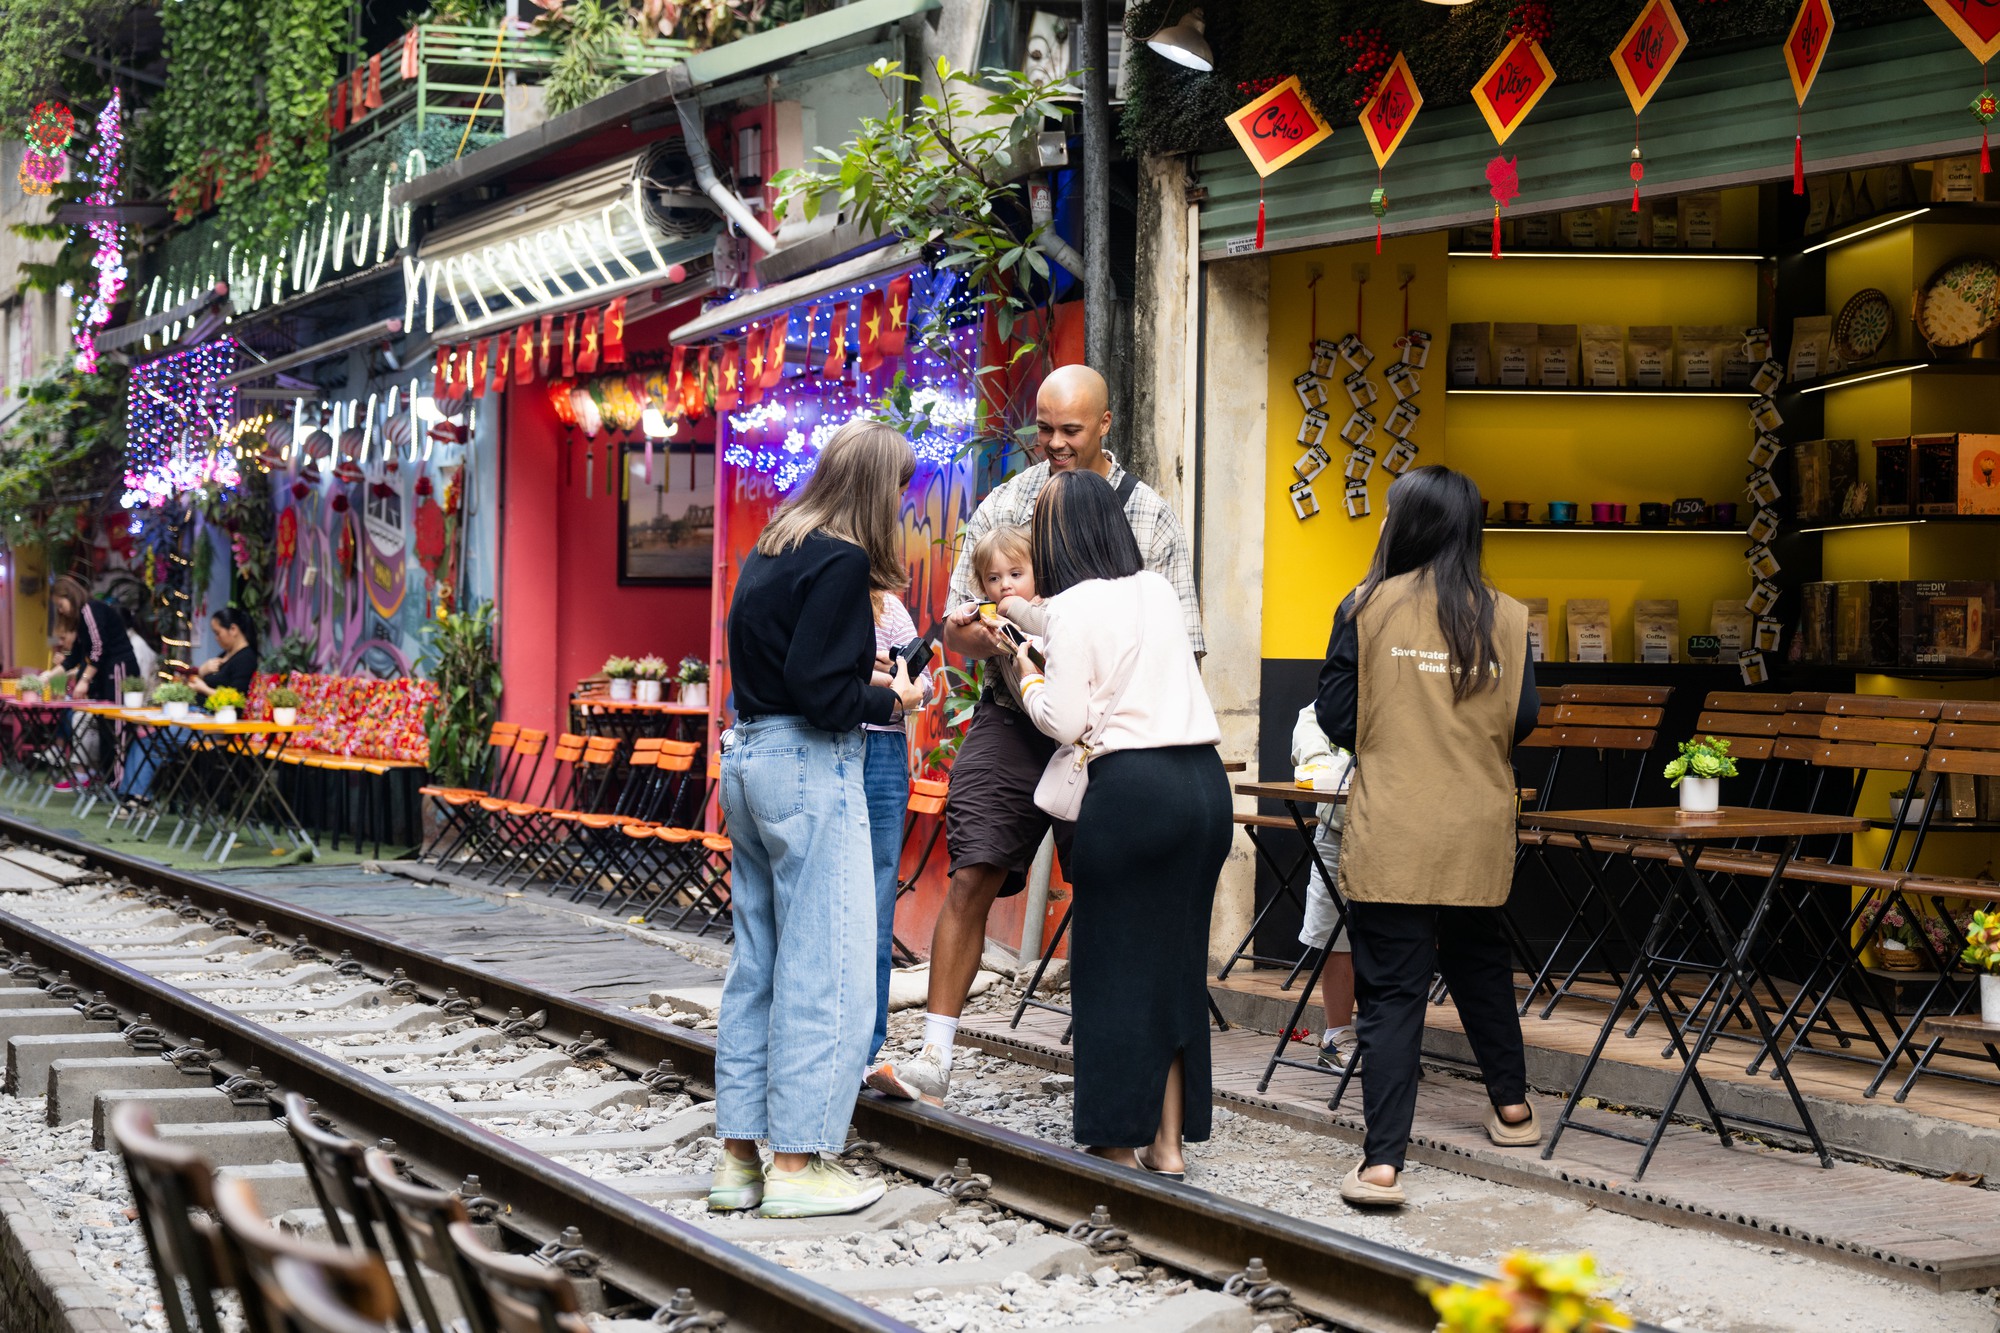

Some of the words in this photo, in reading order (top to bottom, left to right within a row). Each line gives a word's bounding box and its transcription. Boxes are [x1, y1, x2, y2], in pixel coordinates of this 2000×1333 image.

[1252, 105, 1304, 141] Chúc
[735, 465, 776, 504] Here
[1931, 583, 1946, 591] DIY
[1391, 646, 1417, 657] Save
[1419, 649, 1450, 660] water
[1418, 662, 1447, 673] drink
